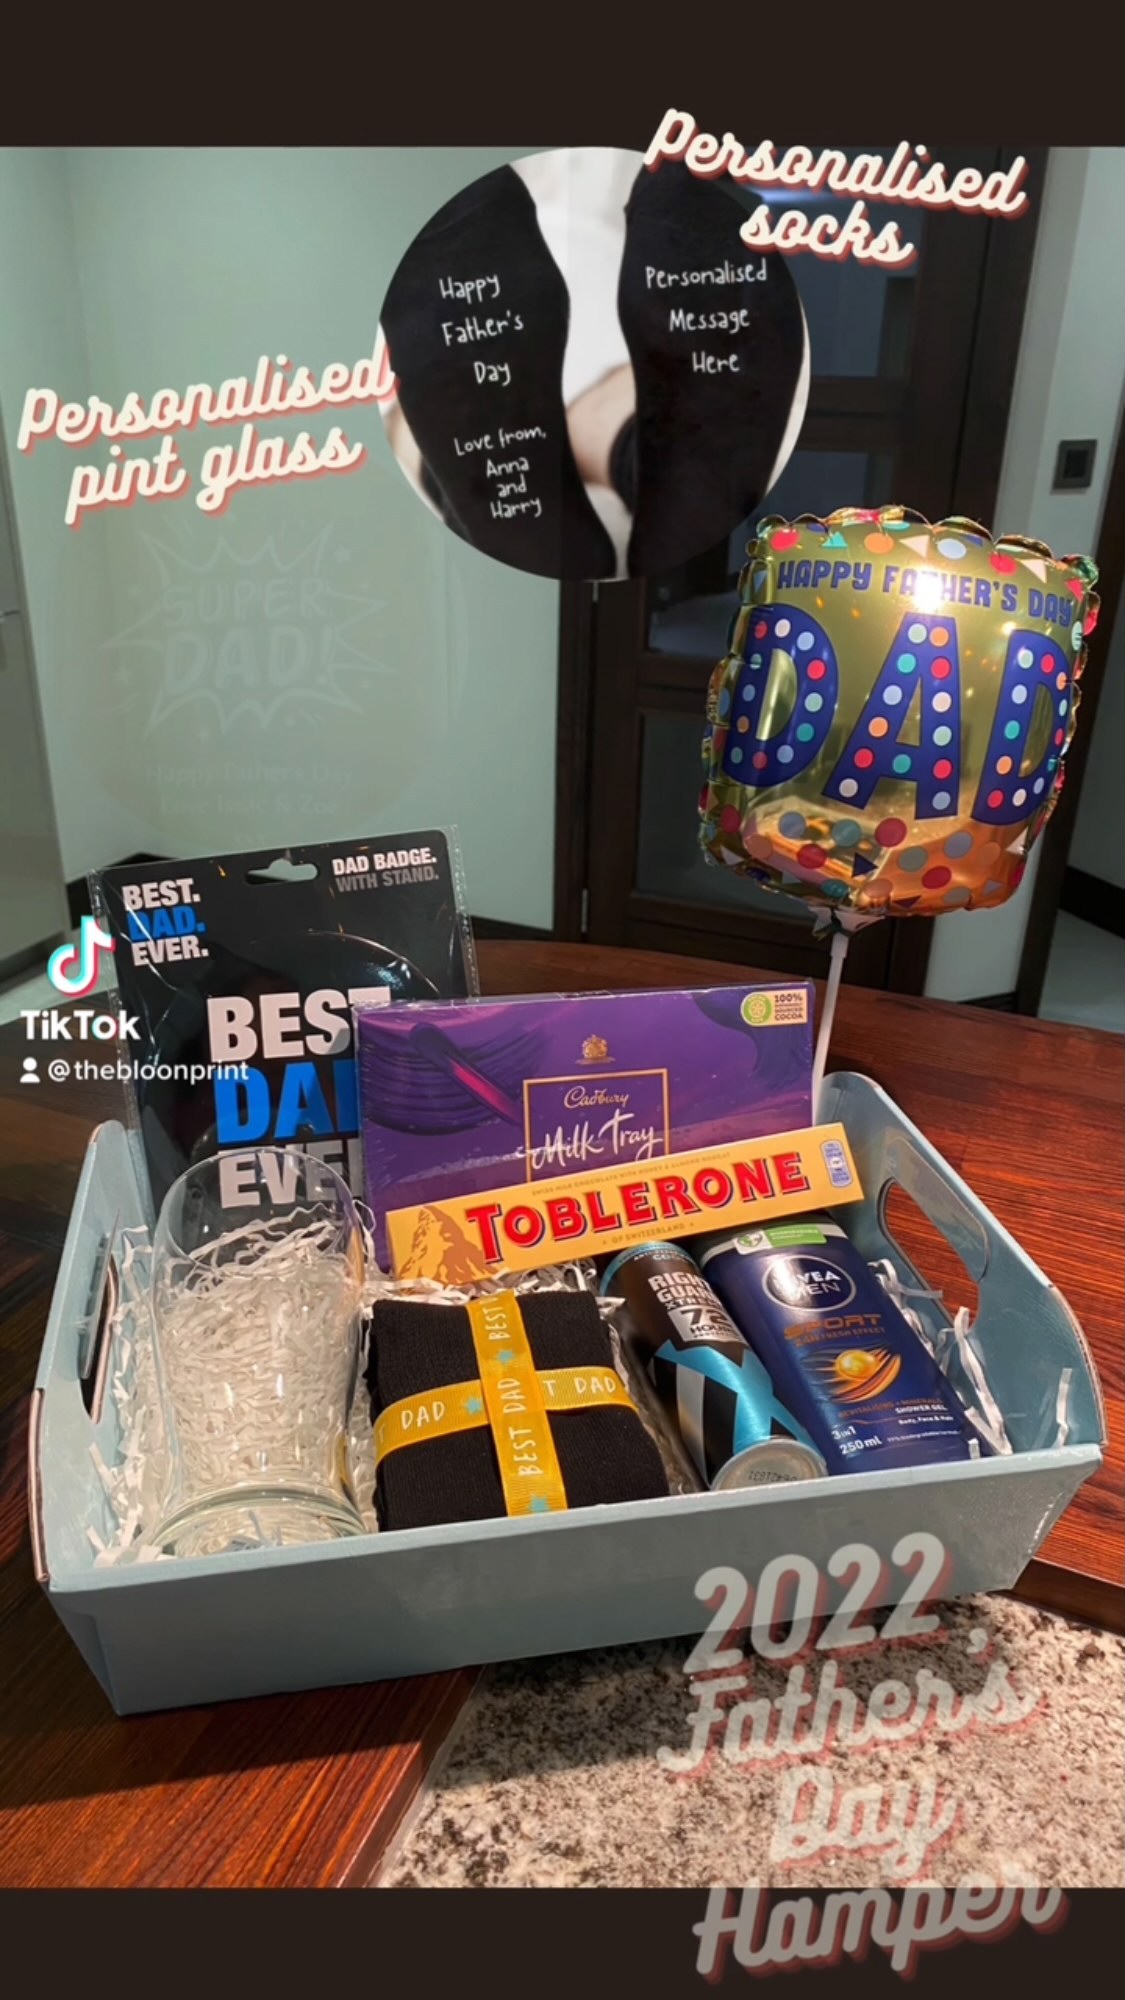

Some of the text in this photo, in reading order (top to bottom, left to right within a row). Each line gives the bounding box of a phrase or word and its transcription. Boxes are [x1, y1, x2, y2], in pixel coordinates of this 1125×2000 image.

[645, 258, 768, 289] Personalised
[438, 274, 501, 304] Happy
[441, 310, 524, 346] Father's
[669, 308, 751, 334] Message
[474, 361, 511, 387] Day
[692, 352, 741, 374] Here
[454, 425, 547, 456] Love from,
[486, 457, 530, 478] Anna
[496, 474, 527, 498] and
[490, 498, 543, 520] Harry
[160, 577, 329, 627] SUPER
[777, 559, 873, 591] HAPPY
[1028, 588, 1074, 628] DAY
[162, 624, 333, 694] DAD!
[721, 603, 1074, 827] DAD
[331, 847, 438, 876] DAD BADGE.
[121, 877, 201, 911] BEST.
[335, 866, 439, 893] WITH STAND.
[126, 905, 207, 943] DAD.
[131, 936, 209, 967] EVER.
[774, 993, 803, 1003] 100%
[564, 1085, 629, 1109] Cadbury
[531, 1108, 664, 1170] Milk Tray
[466, 1151, 812, 1266] TOBLERONE
[611, 1223, 686, 1244] OF SWITZERLAND
[656, 1285, 719, 1303] GUAR
[681, 1308, 732, 1328] 72
[784, 1313, 882, 1339] SPORT
[482, 1293, 544, 1478] BEST DAD BEST
[573, 1377, 617, 1395] DAD
[401, 1400, 446, 1430] DAD
[895, 1404, 930, 1413] SHOWER
